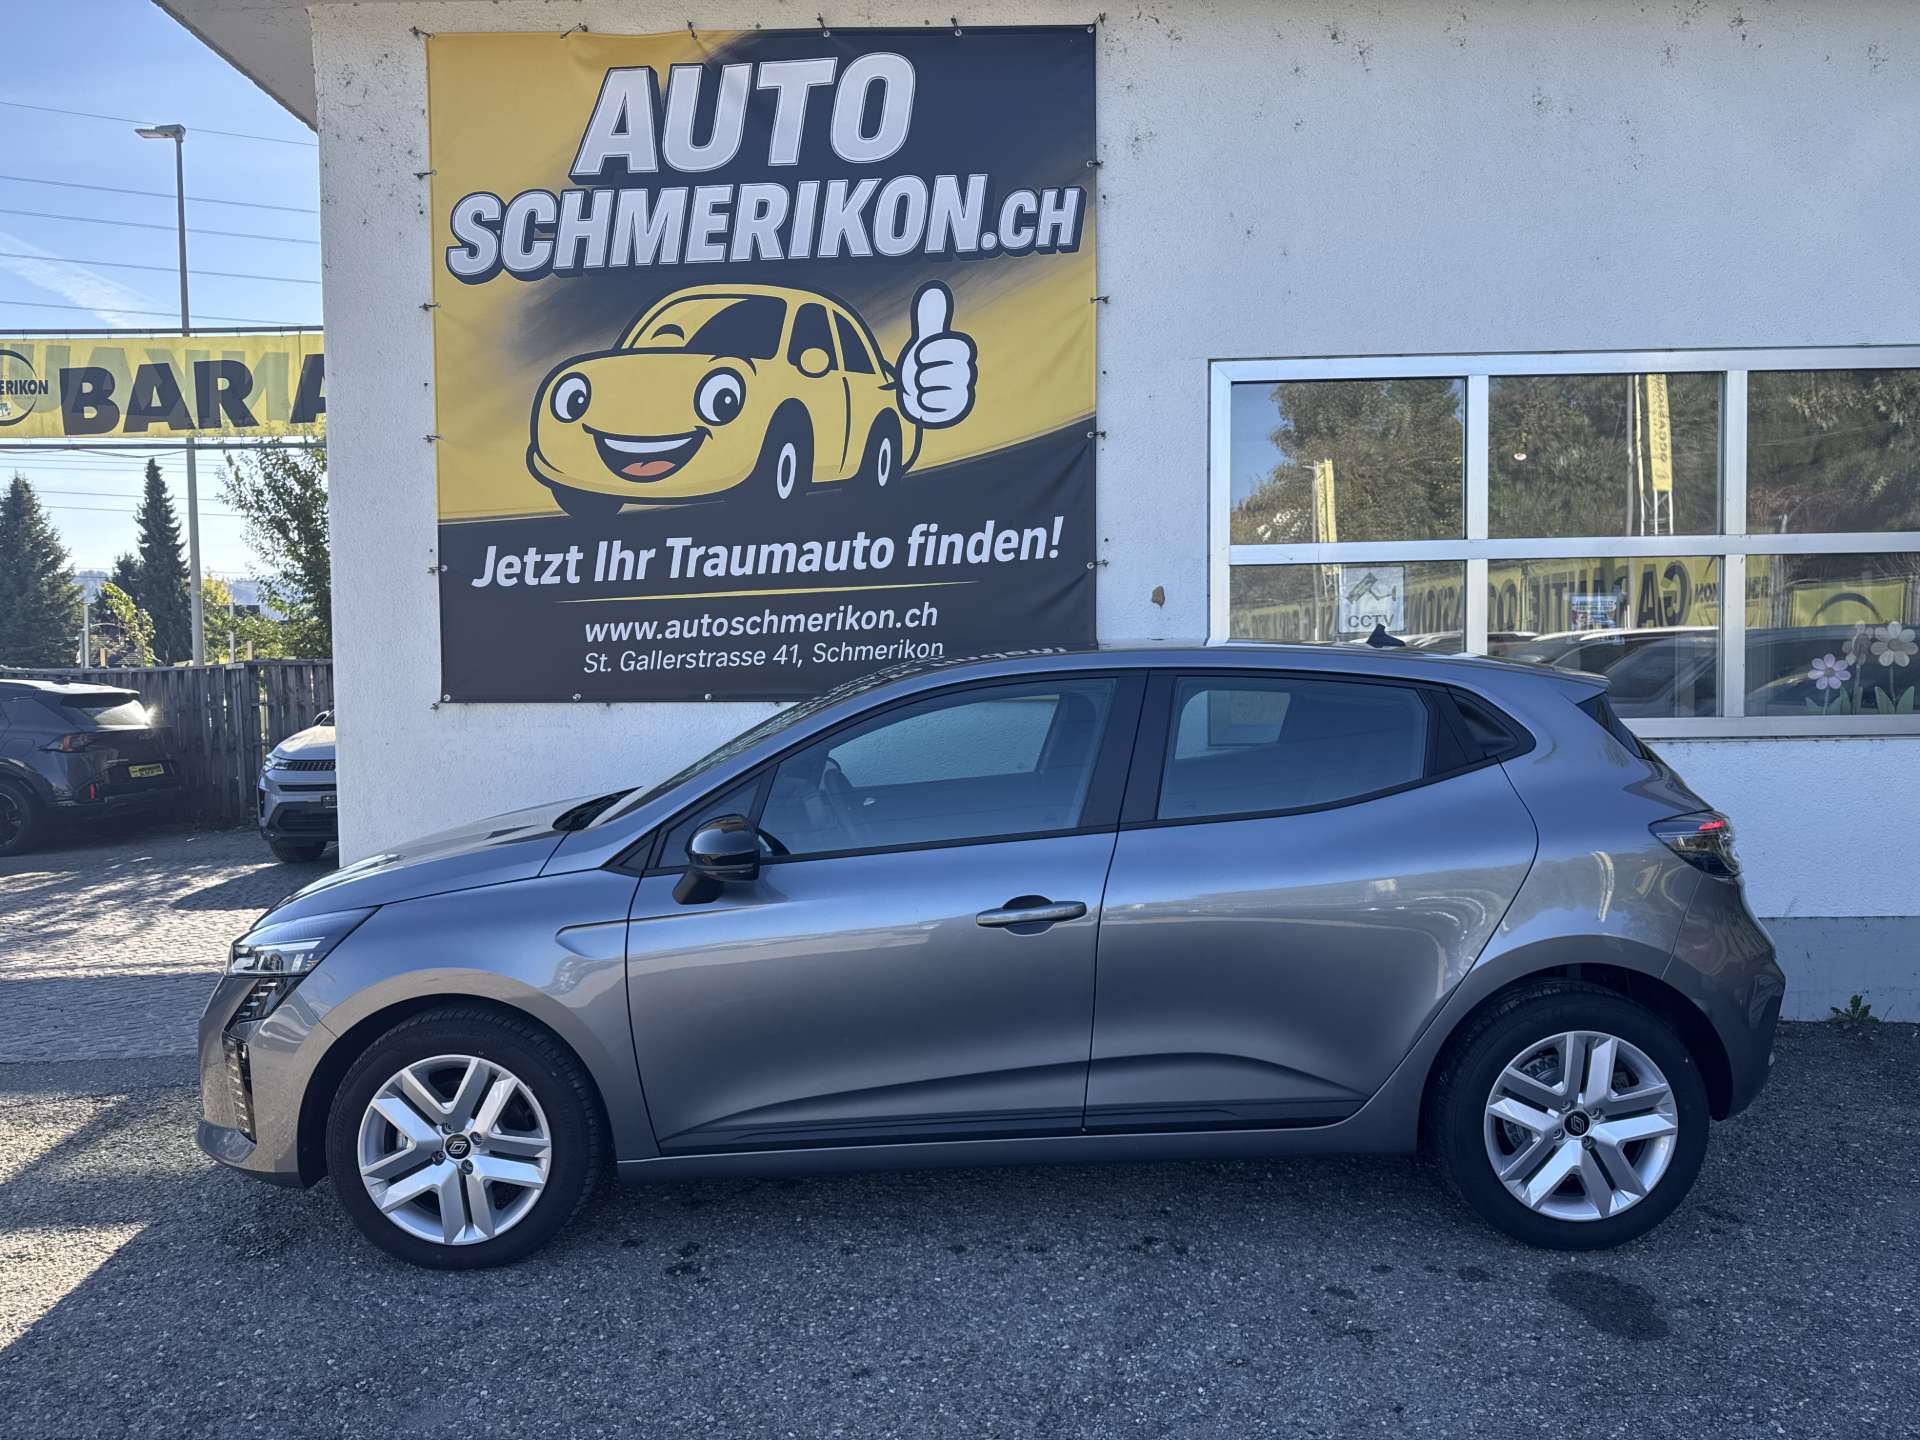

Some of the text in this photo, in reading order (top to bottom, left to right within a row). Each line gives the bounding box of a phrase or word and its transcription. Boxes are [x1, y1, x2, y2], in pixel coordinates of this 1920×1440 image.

[571, 51, 917, 176] AUTO
[447, 172, 1083, 278] SCHMERIKON.CH
[471, 515, 1064, 588] Jetzt Ihr Traumauto finden!
[585, 601, 938, 643] www.autoschmerikon.ch
[1348, 614, 1394, 628] CCTV
[583, 639, 944, 673] St. Gallerstrasse 41, Schmerikon
